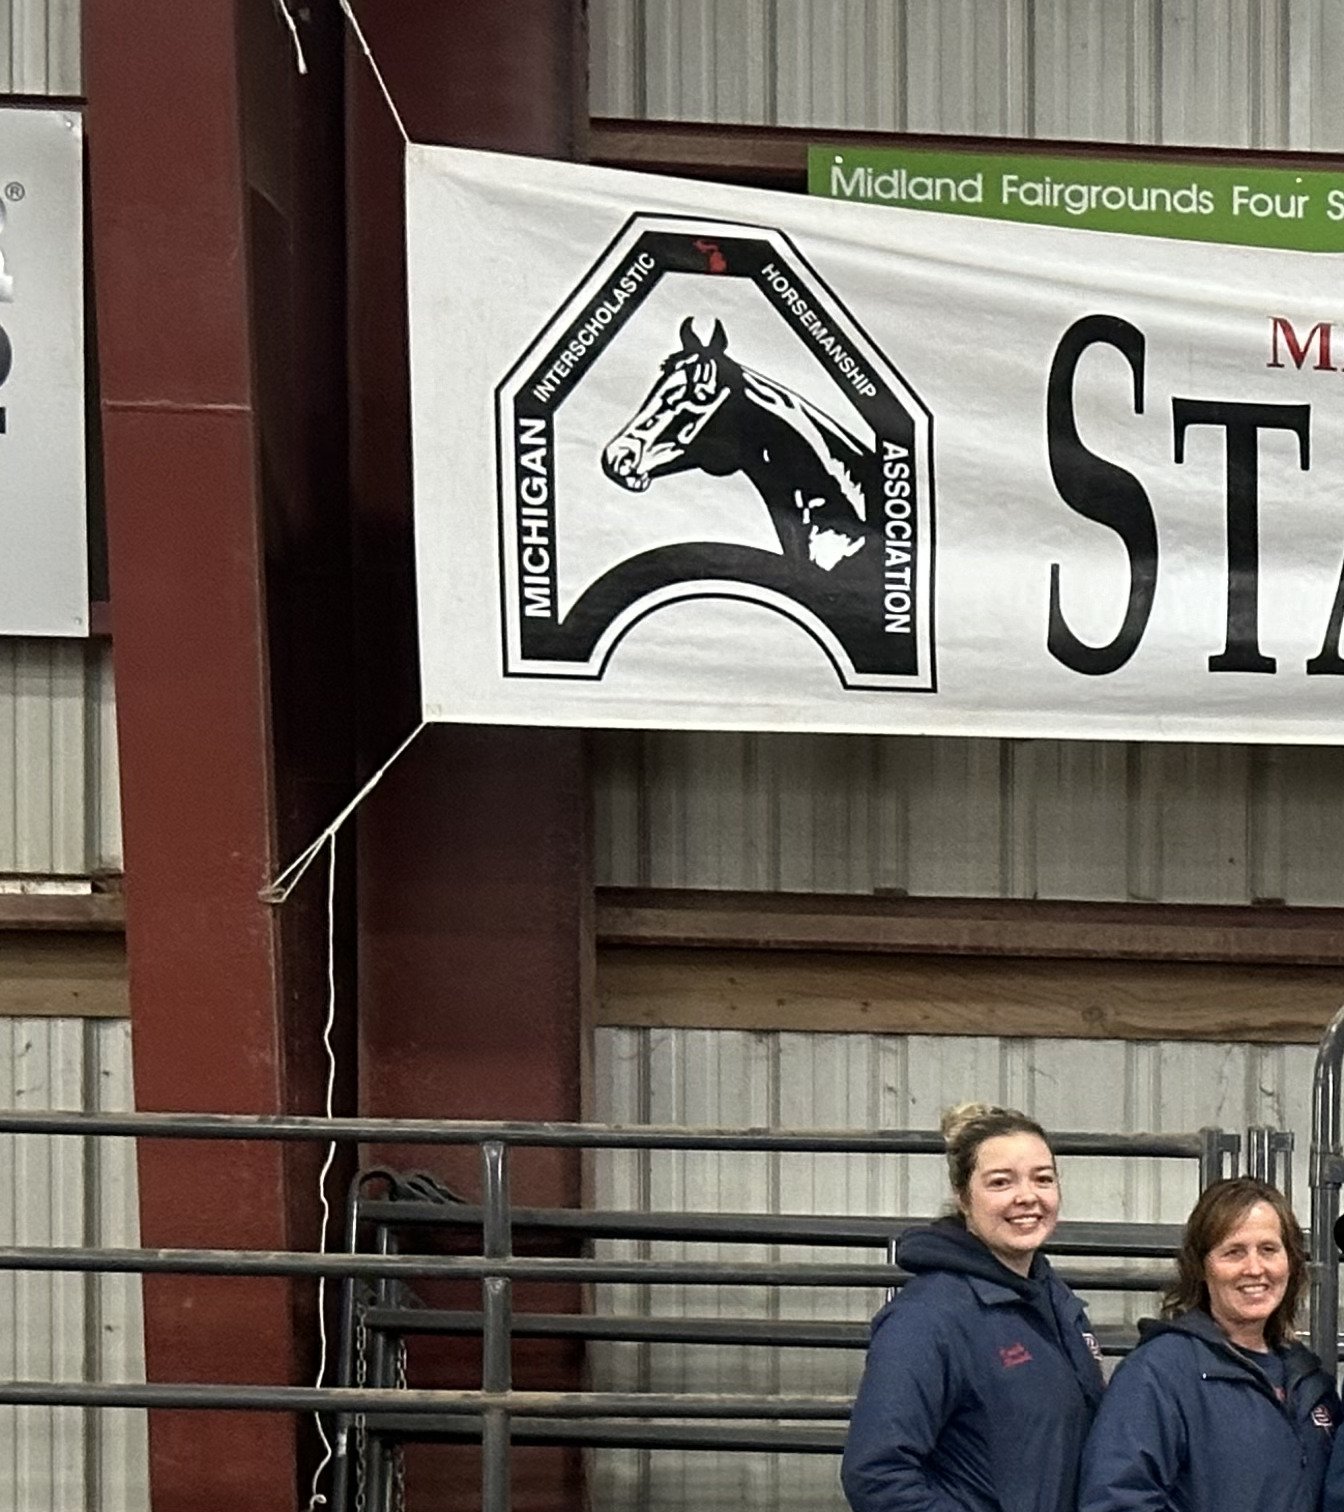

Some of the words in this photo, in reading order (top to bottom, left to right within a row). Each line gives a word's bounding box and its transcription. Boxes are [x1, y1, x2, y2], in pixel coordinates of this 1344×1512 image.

[830, 163, 983, 203] Midland
[1002, 174, 1214, 215] Fairgrounds
[1232, 186, 1309, 219] Four
[533, 252, 656, 403] INTERSCHOLASTIC
[761, 262, 878, 400] HORSEMANSHIP
[519, 417, 552, 618] MICHIGAN
[882, 440, 912, 634] ASSOCIATION
